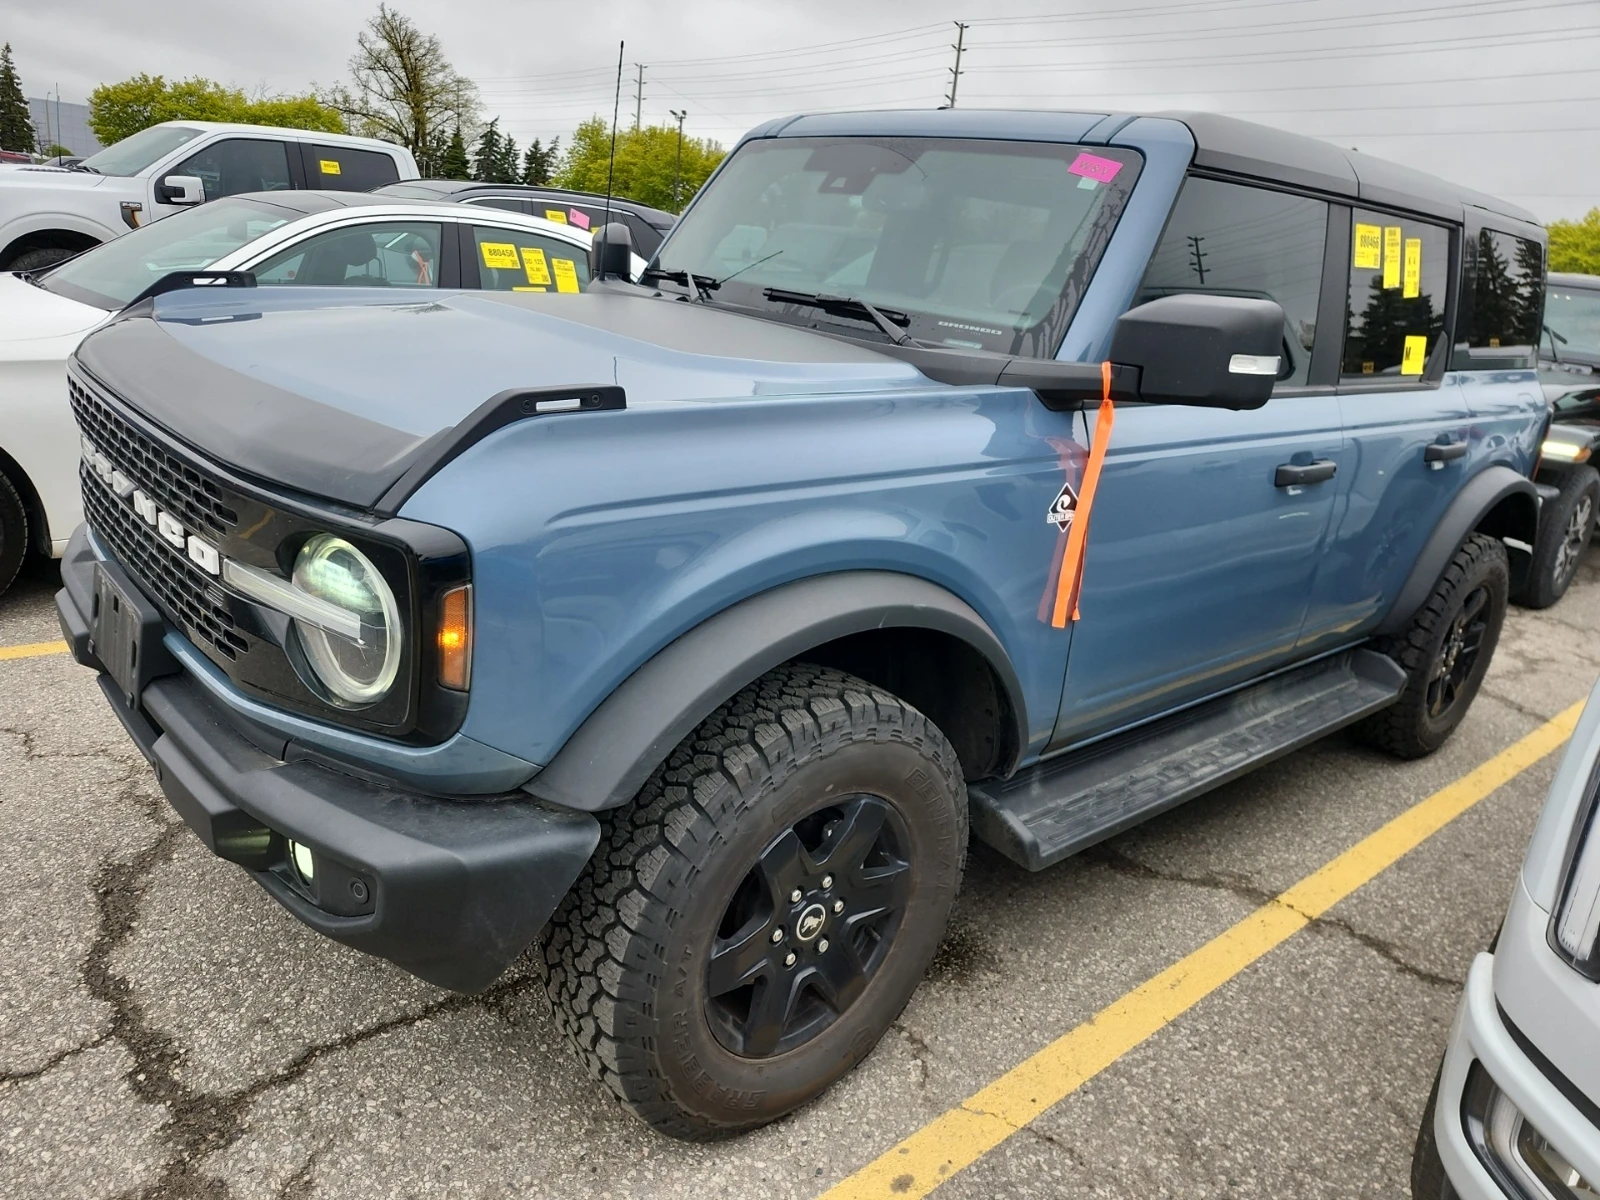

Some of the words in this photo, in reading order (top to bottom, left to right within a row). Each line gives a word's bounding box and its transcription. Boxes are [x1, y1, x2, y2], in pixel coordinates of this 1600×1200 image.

[488, 249, 514, 257] 880458
[938, 321, 1003, 335] BRONCO
[80, 436, 220, 575] BRONCO
[674, 944, 692, 997] A/T
[671, 1010, 767, 1111] GRABBER
